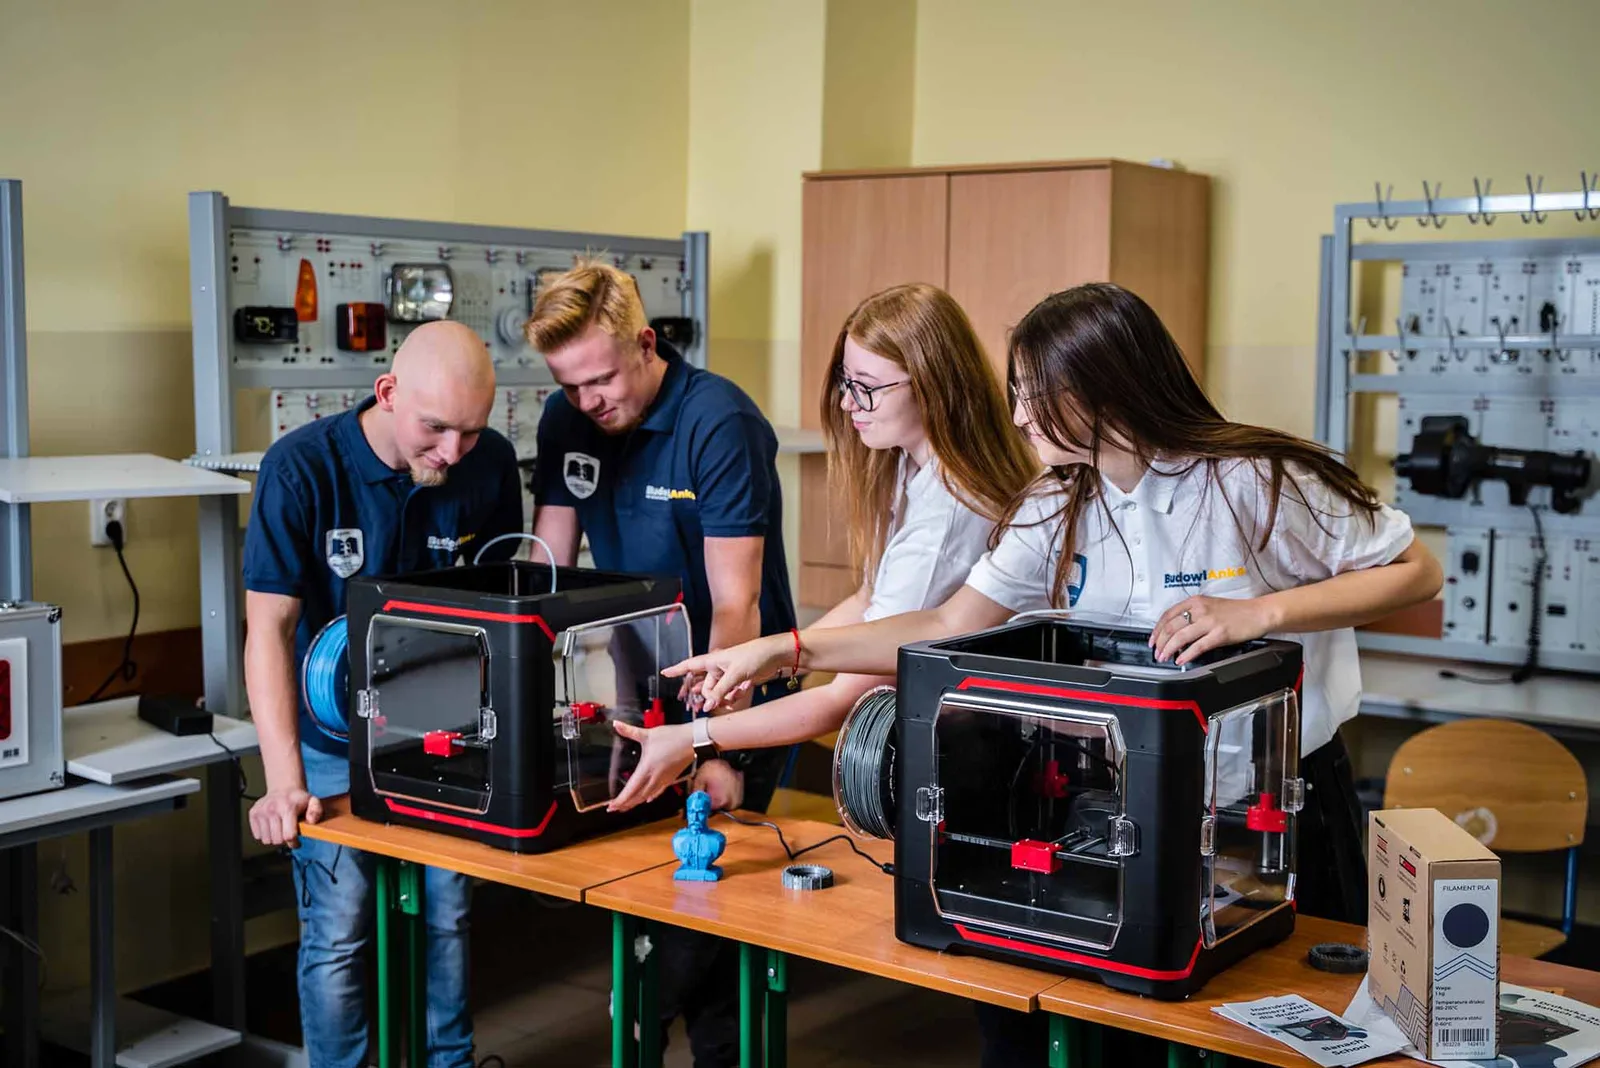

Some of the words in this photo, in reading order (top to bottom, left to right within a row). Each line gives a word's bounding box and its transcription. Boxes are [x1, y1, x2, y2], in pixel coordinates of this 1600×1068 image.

[1250, 1002, 1297, 1012] Instrukcja
[1275, 1007, 1314, 1017] drukarki
[1539, 1002, 1586, 1016] Drukarka
[1534, 1004, 1572, 1016] Banach
[1575, 1015, 1600, 1026] Scho
[1320, 1039, 1364, 1051] Banach
[1331, 1043, 1371, 1055] School
